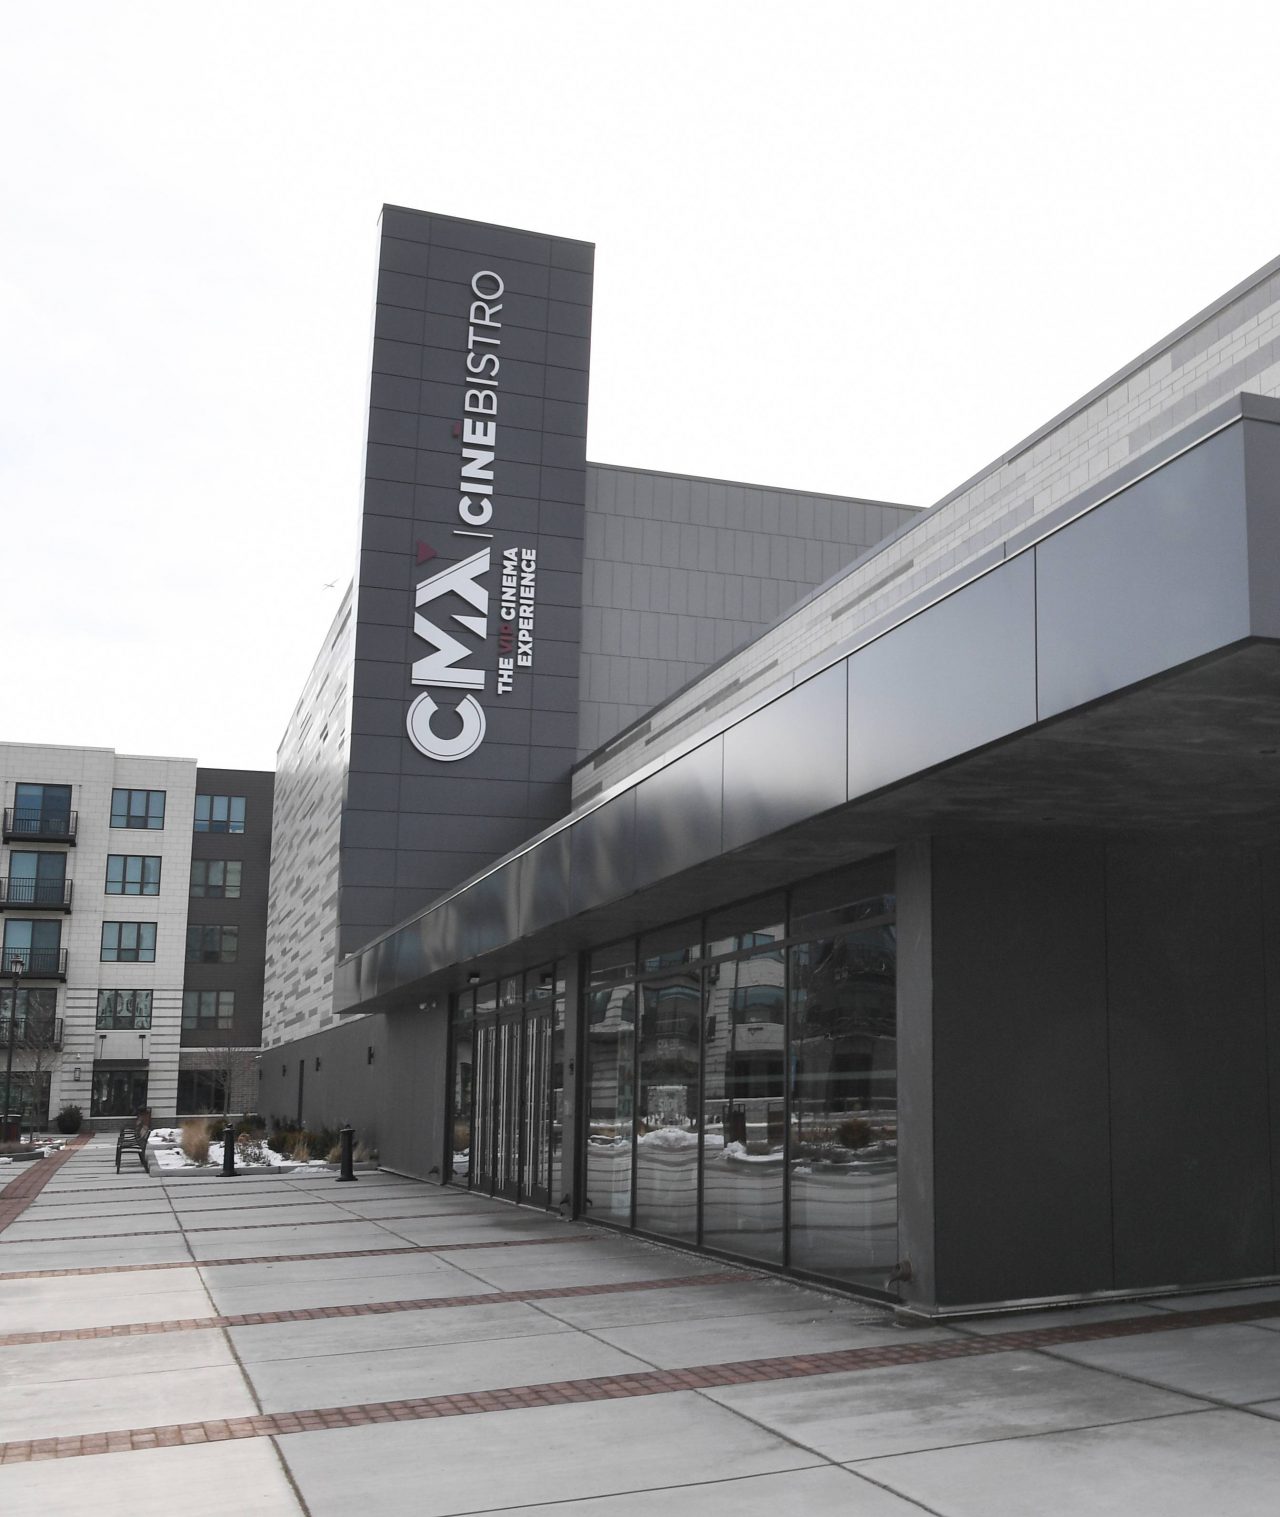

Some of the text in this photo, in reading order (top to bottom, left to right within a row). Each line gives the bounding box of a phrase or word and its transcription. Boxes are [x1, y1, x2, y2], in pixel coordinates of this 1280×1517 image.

[406, 546, 491, 762] CMX
[498, 547, 518, 694] THE VIP CINEMA
[517, 549, 536, 667] EXPERIENCE
